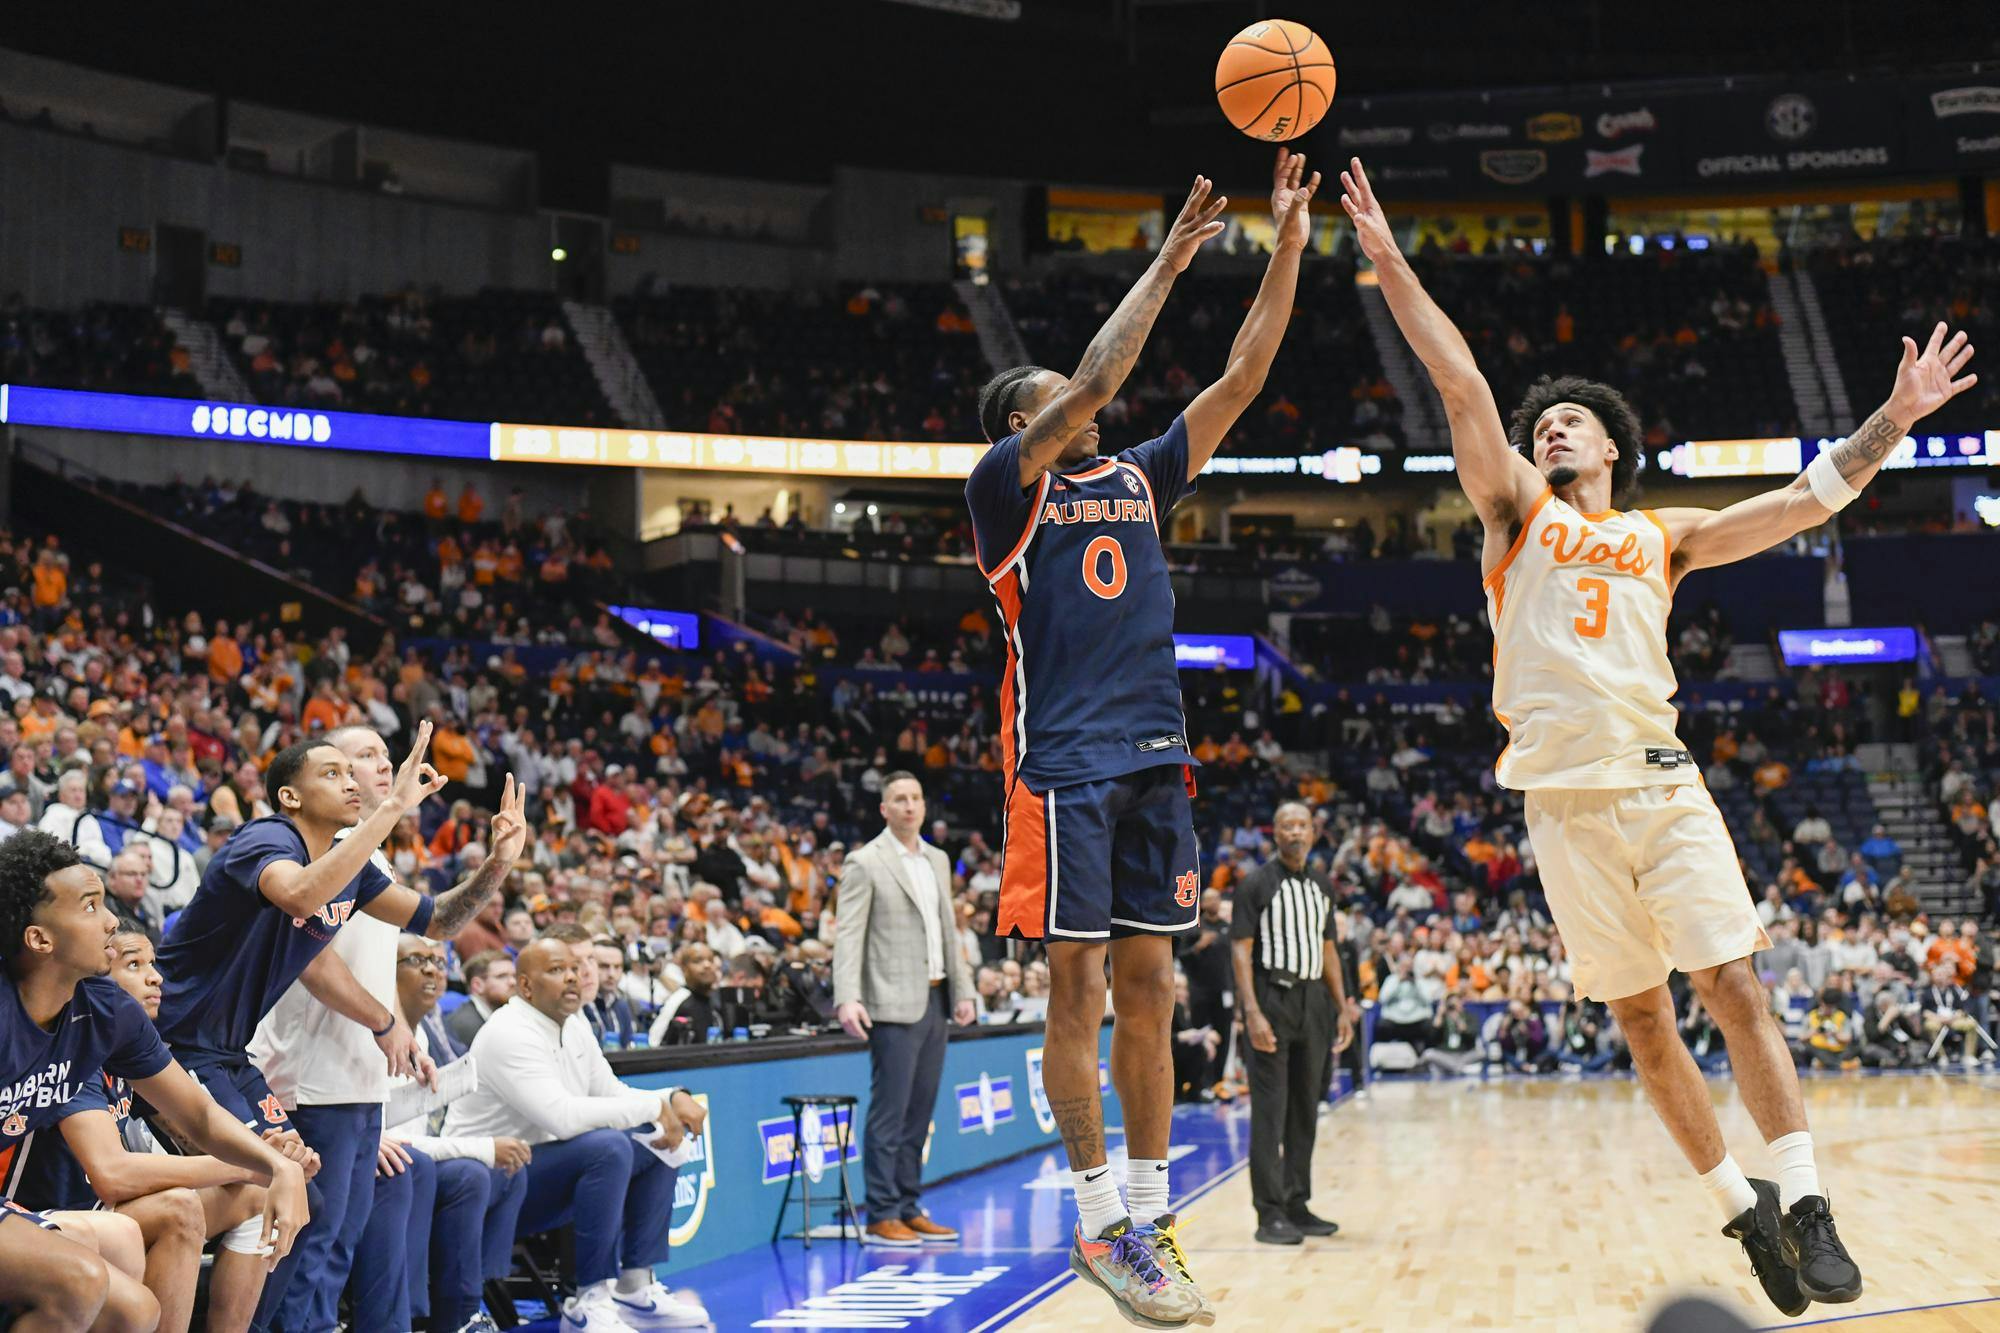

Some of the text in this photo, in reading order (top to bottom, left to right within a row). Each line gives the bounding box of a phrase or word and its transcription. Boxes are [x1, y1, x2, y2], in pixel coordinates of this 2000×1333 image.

[1697, 146, 1888, 178] OFFICIAL SPONSORS
[192, 405, 331, 442] #SECMBB
[1040, 499, 1150, 525] AUBURN
[1082, 535, 1128, 600] 0
[1539, 522, 1654, 577] Vols
[1574, 577, 1611, 639] 3
